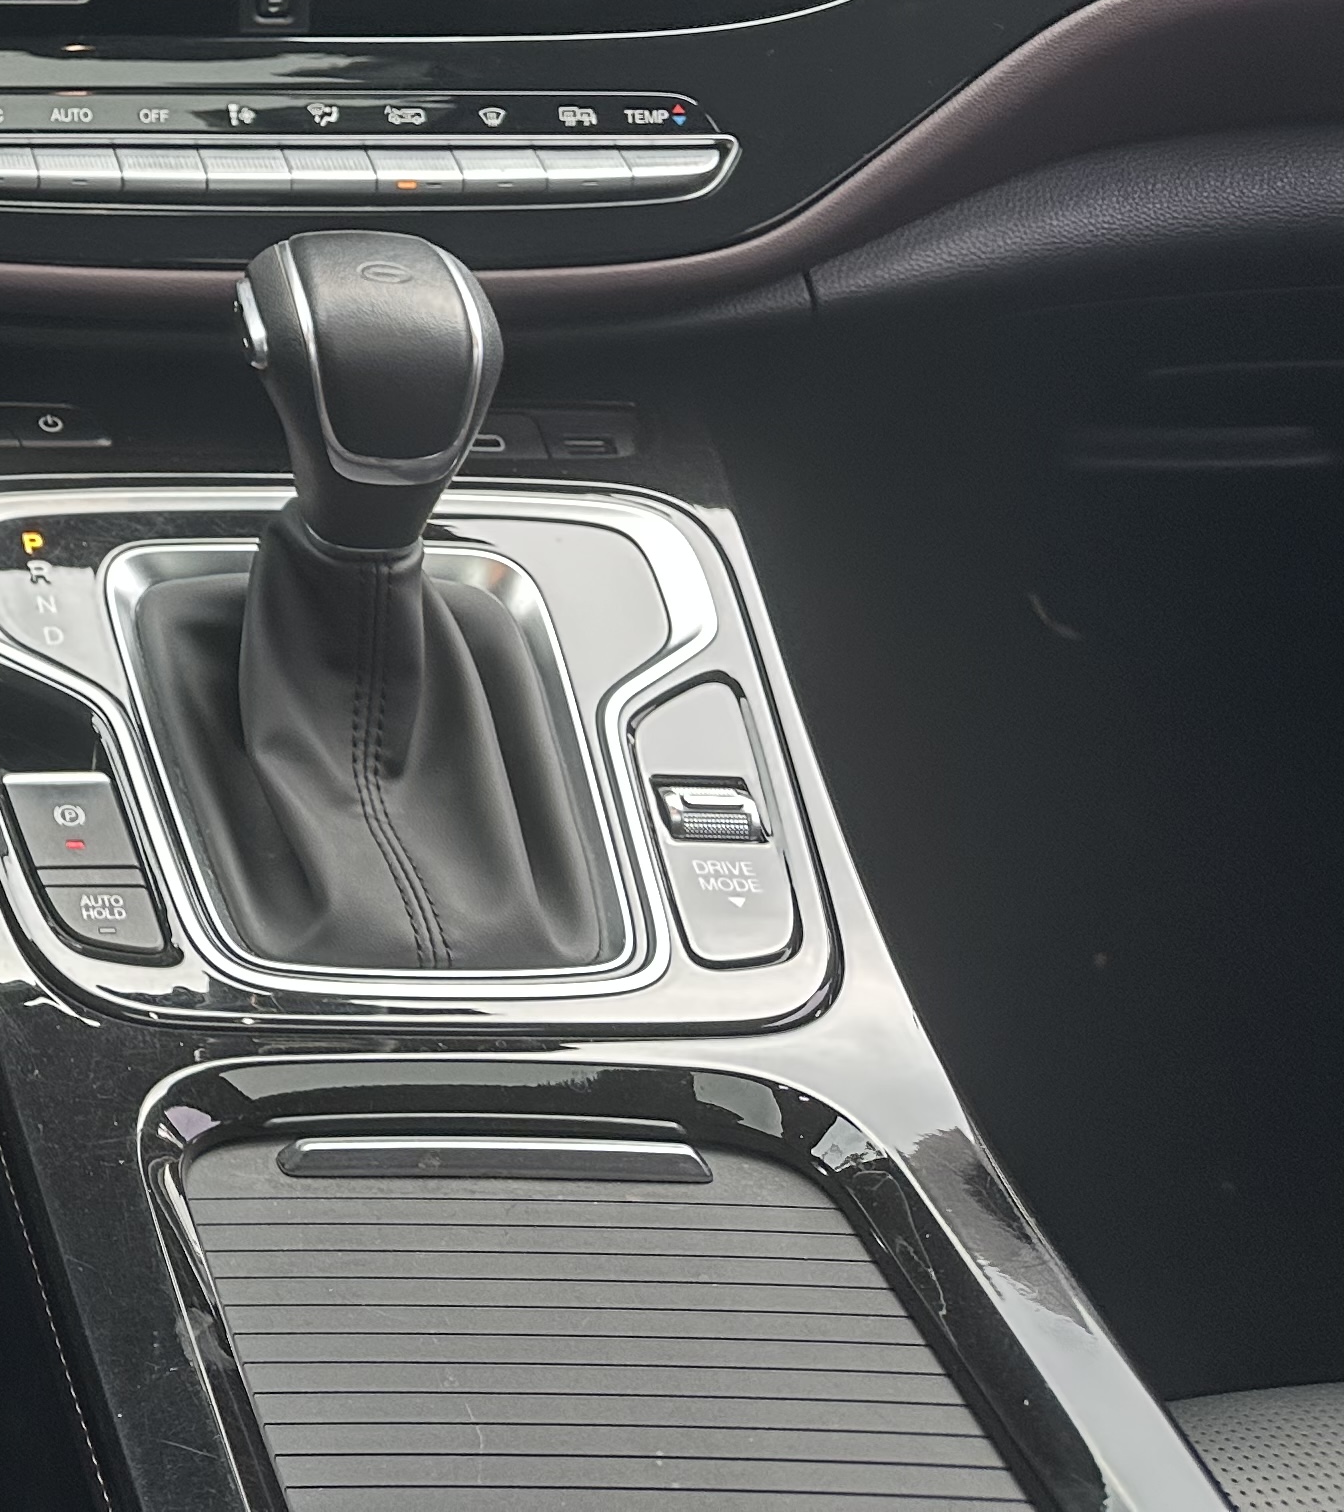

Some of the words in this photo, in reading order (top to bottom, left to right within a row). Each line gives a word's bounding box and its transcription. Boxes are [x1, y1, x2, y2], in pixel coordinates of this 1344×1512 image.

[50, 107, 94, 123] AUTO
[139, 108, 170, 124] OFF
[623, 108, 670, 124] TEMP
[21, 531, 45, 555] P
[26, 559, 53, 585] R
[36, 594, 58, 614] N
[43, 626, 65, 646] D
[692, 859, 757, 877] DRIVE
[698, 876, 764, 894] MODE
[79, 894, 124, 908] AUTO
[81, 908, 127, 921] HOLD
